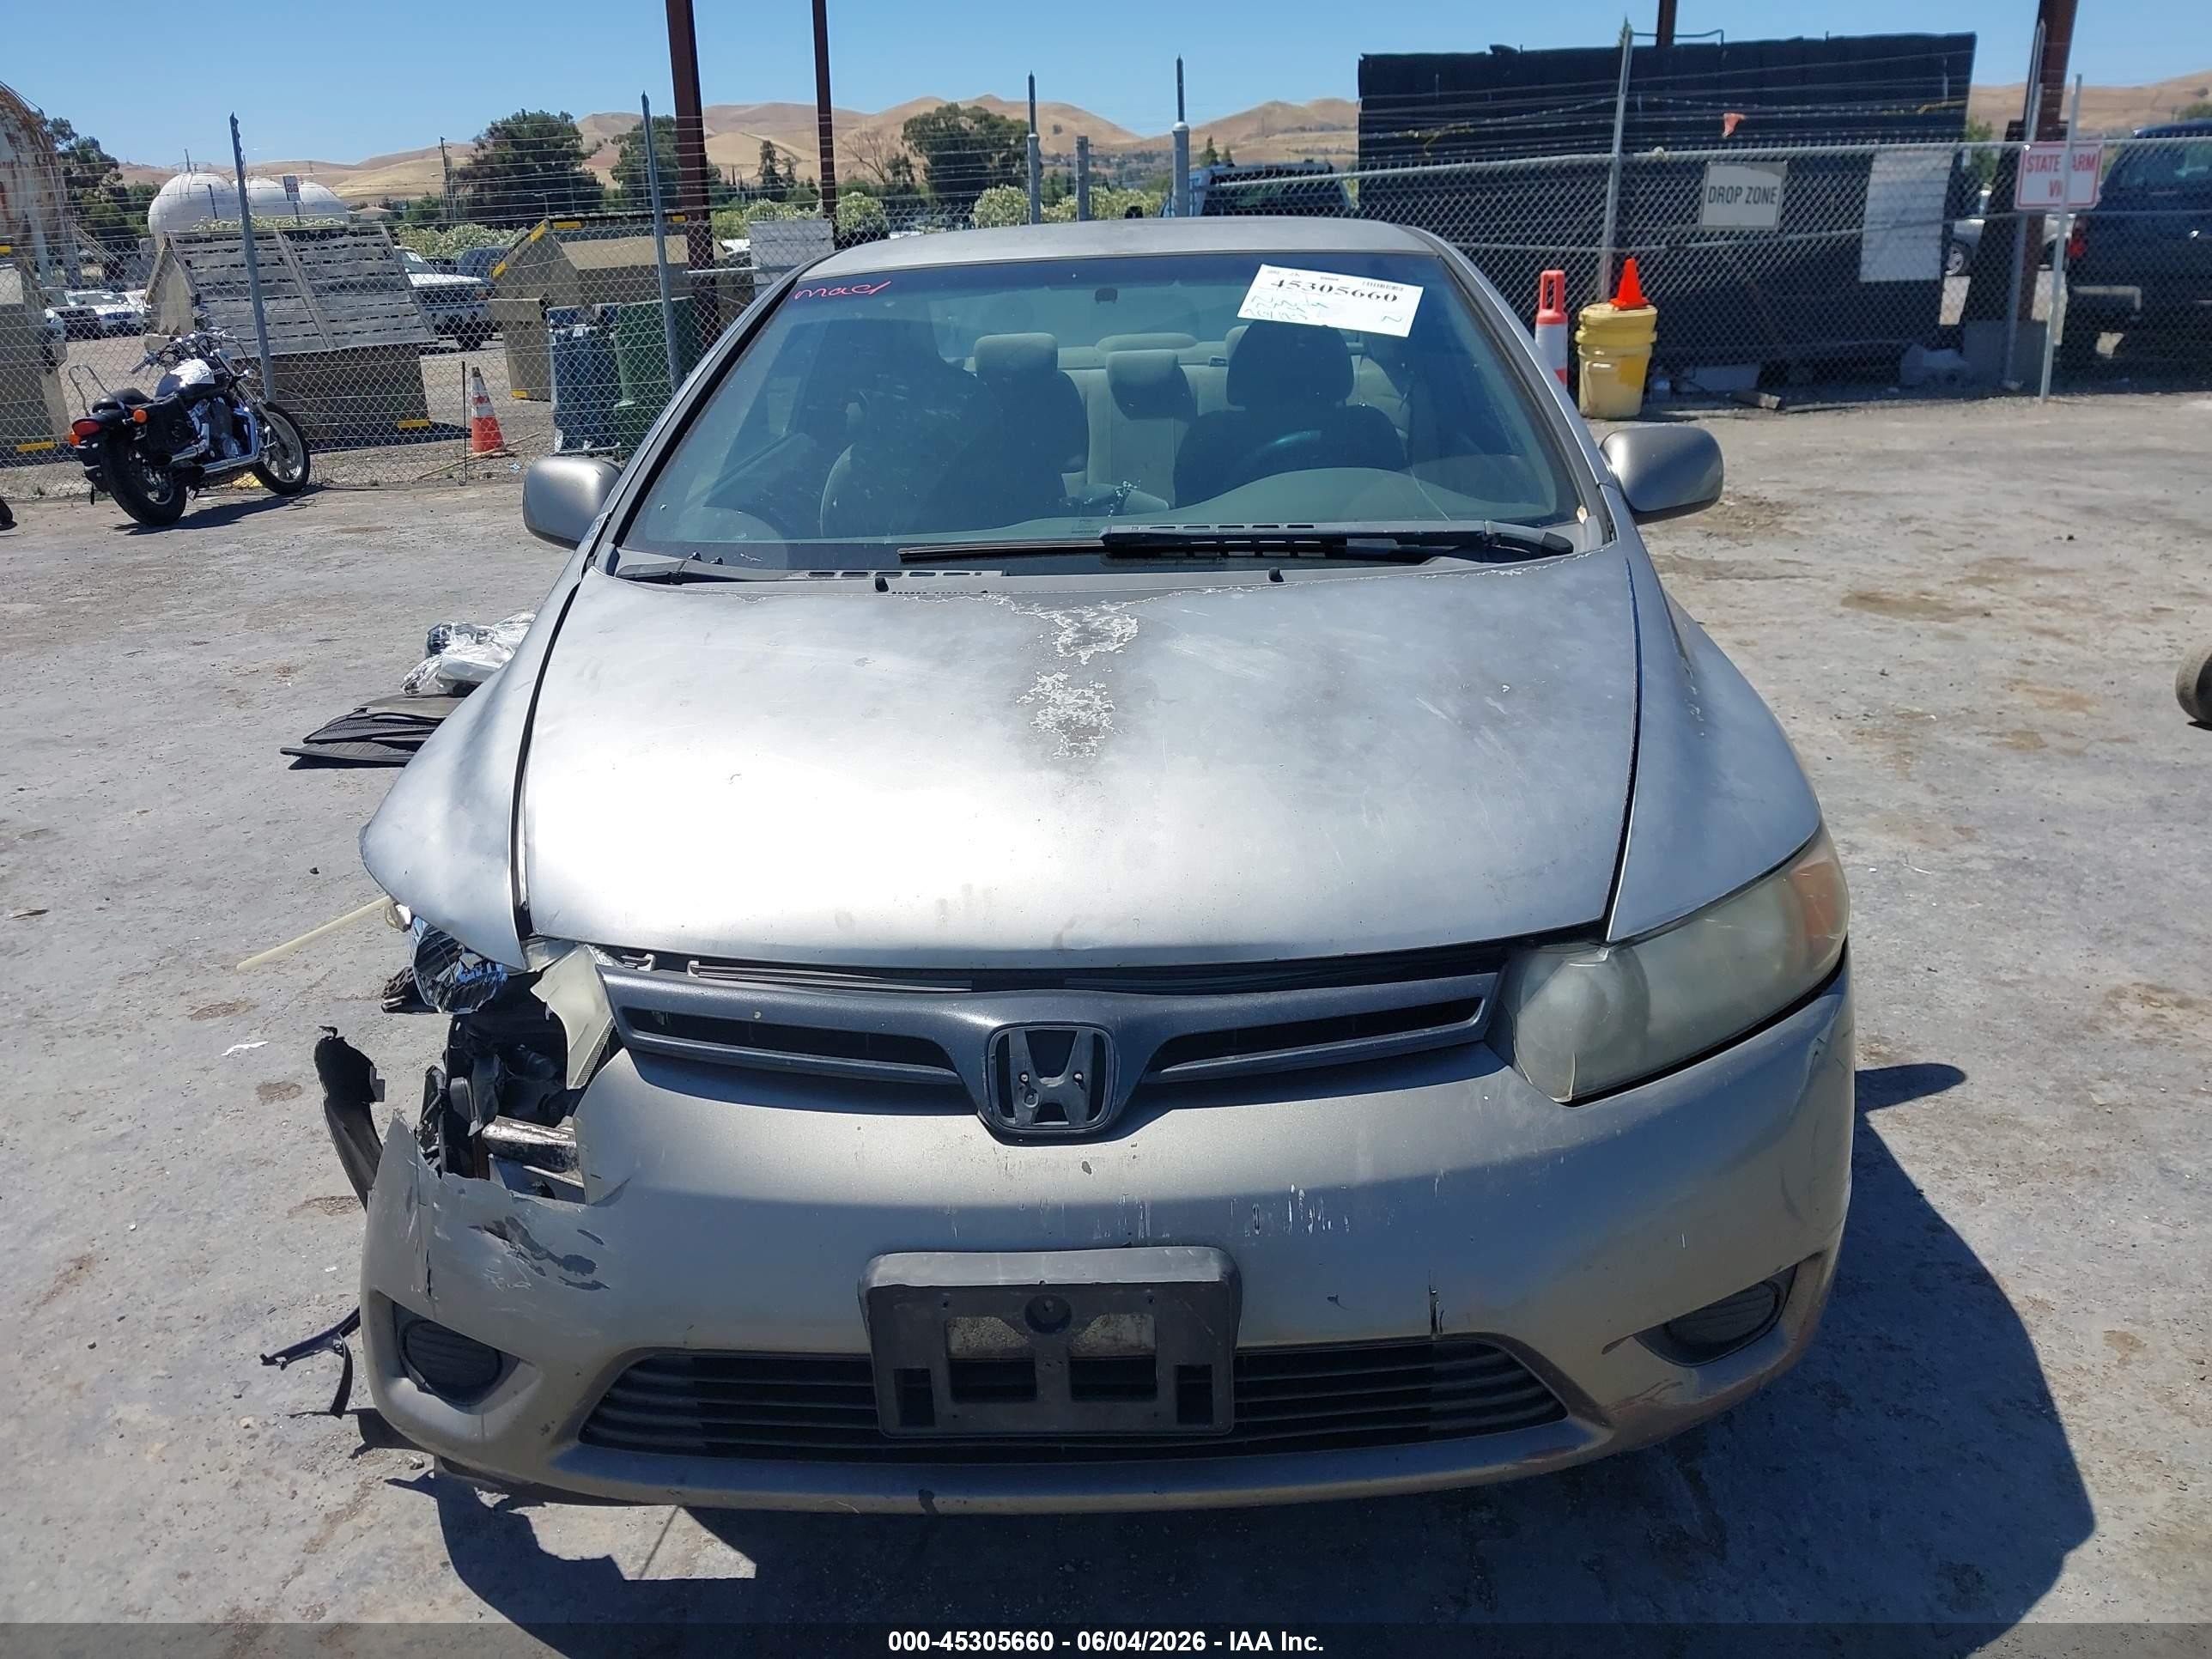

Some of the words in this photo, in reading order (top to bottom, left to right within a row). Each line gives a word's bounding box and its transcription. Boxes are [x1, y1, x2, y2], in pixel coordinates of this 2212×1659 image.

[2026, 154, 2062, 173] STATE
[2072, 153, 2097, 172] ARM
[1708, 185, 1743, 204] DROP
[1745, 185, 1778, 205] ZONE
[1271, 279, 1398, 303] 45305660
